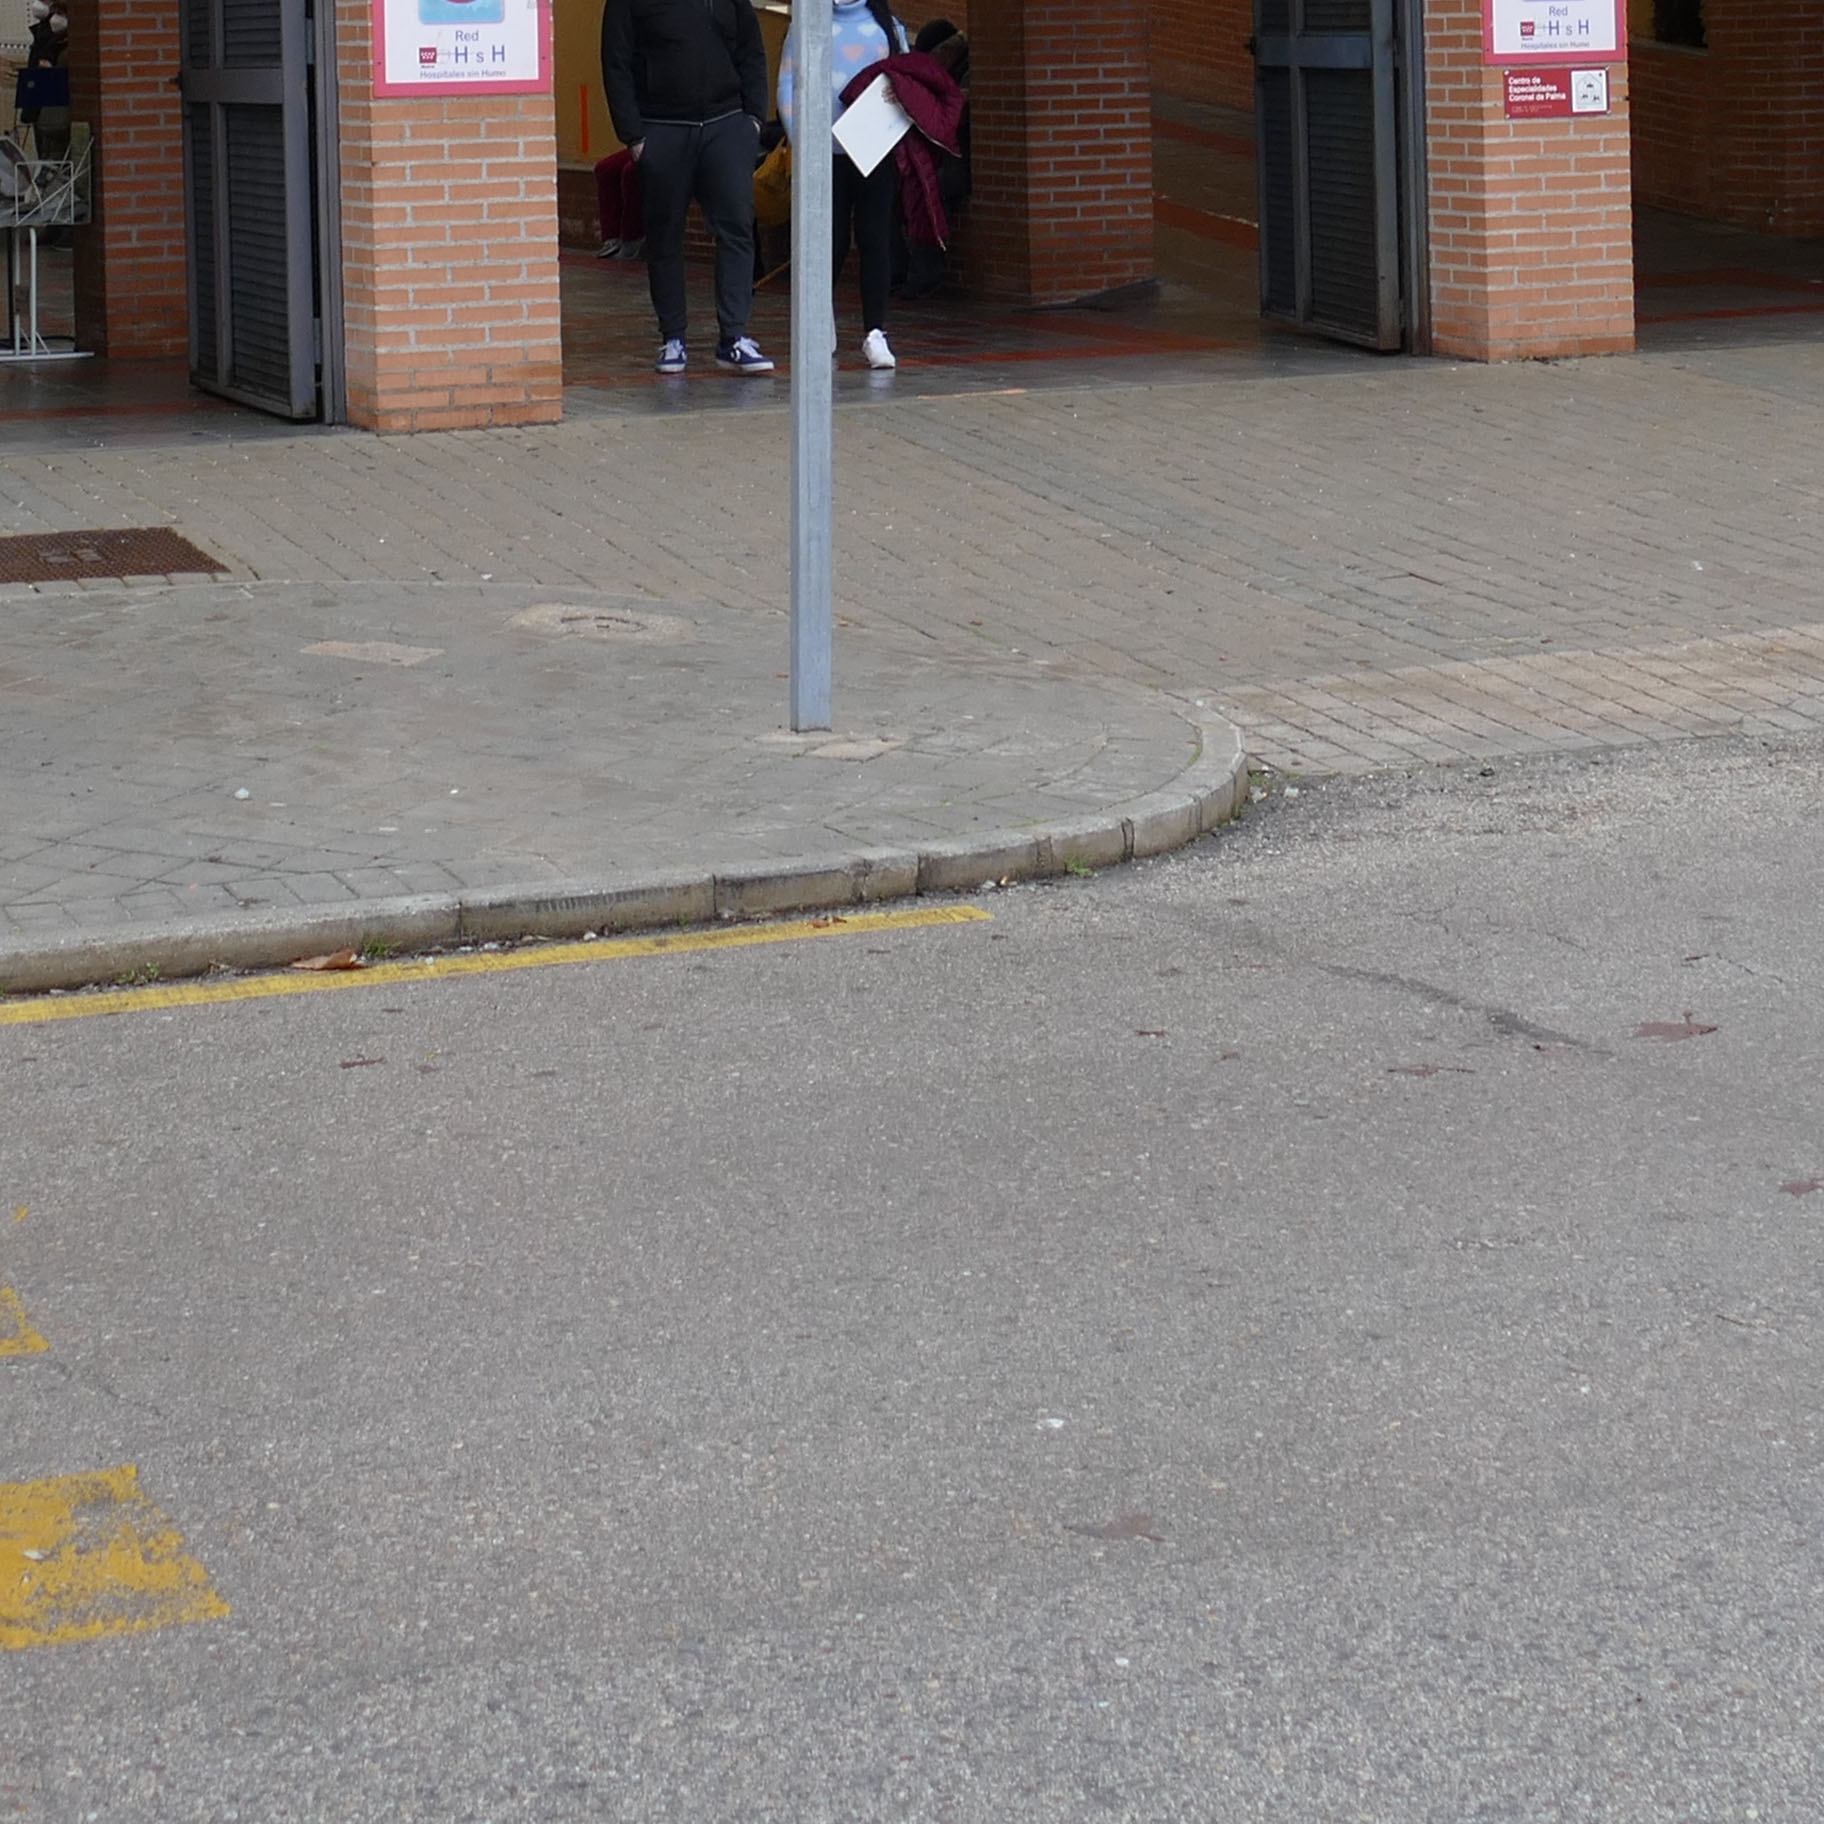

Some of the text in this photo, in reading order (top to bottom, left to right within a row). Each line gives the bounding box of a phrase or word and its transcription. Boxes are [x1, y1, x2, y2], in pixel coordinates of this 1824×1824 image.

[1549, 5, 1568, 16] Red
[455, 29, 479, 42] Red
[1508, 76, 1541, 85] Centro de
[1536, 93, 1544, 101] de
[1545, 92, 1566, 101] Palma
